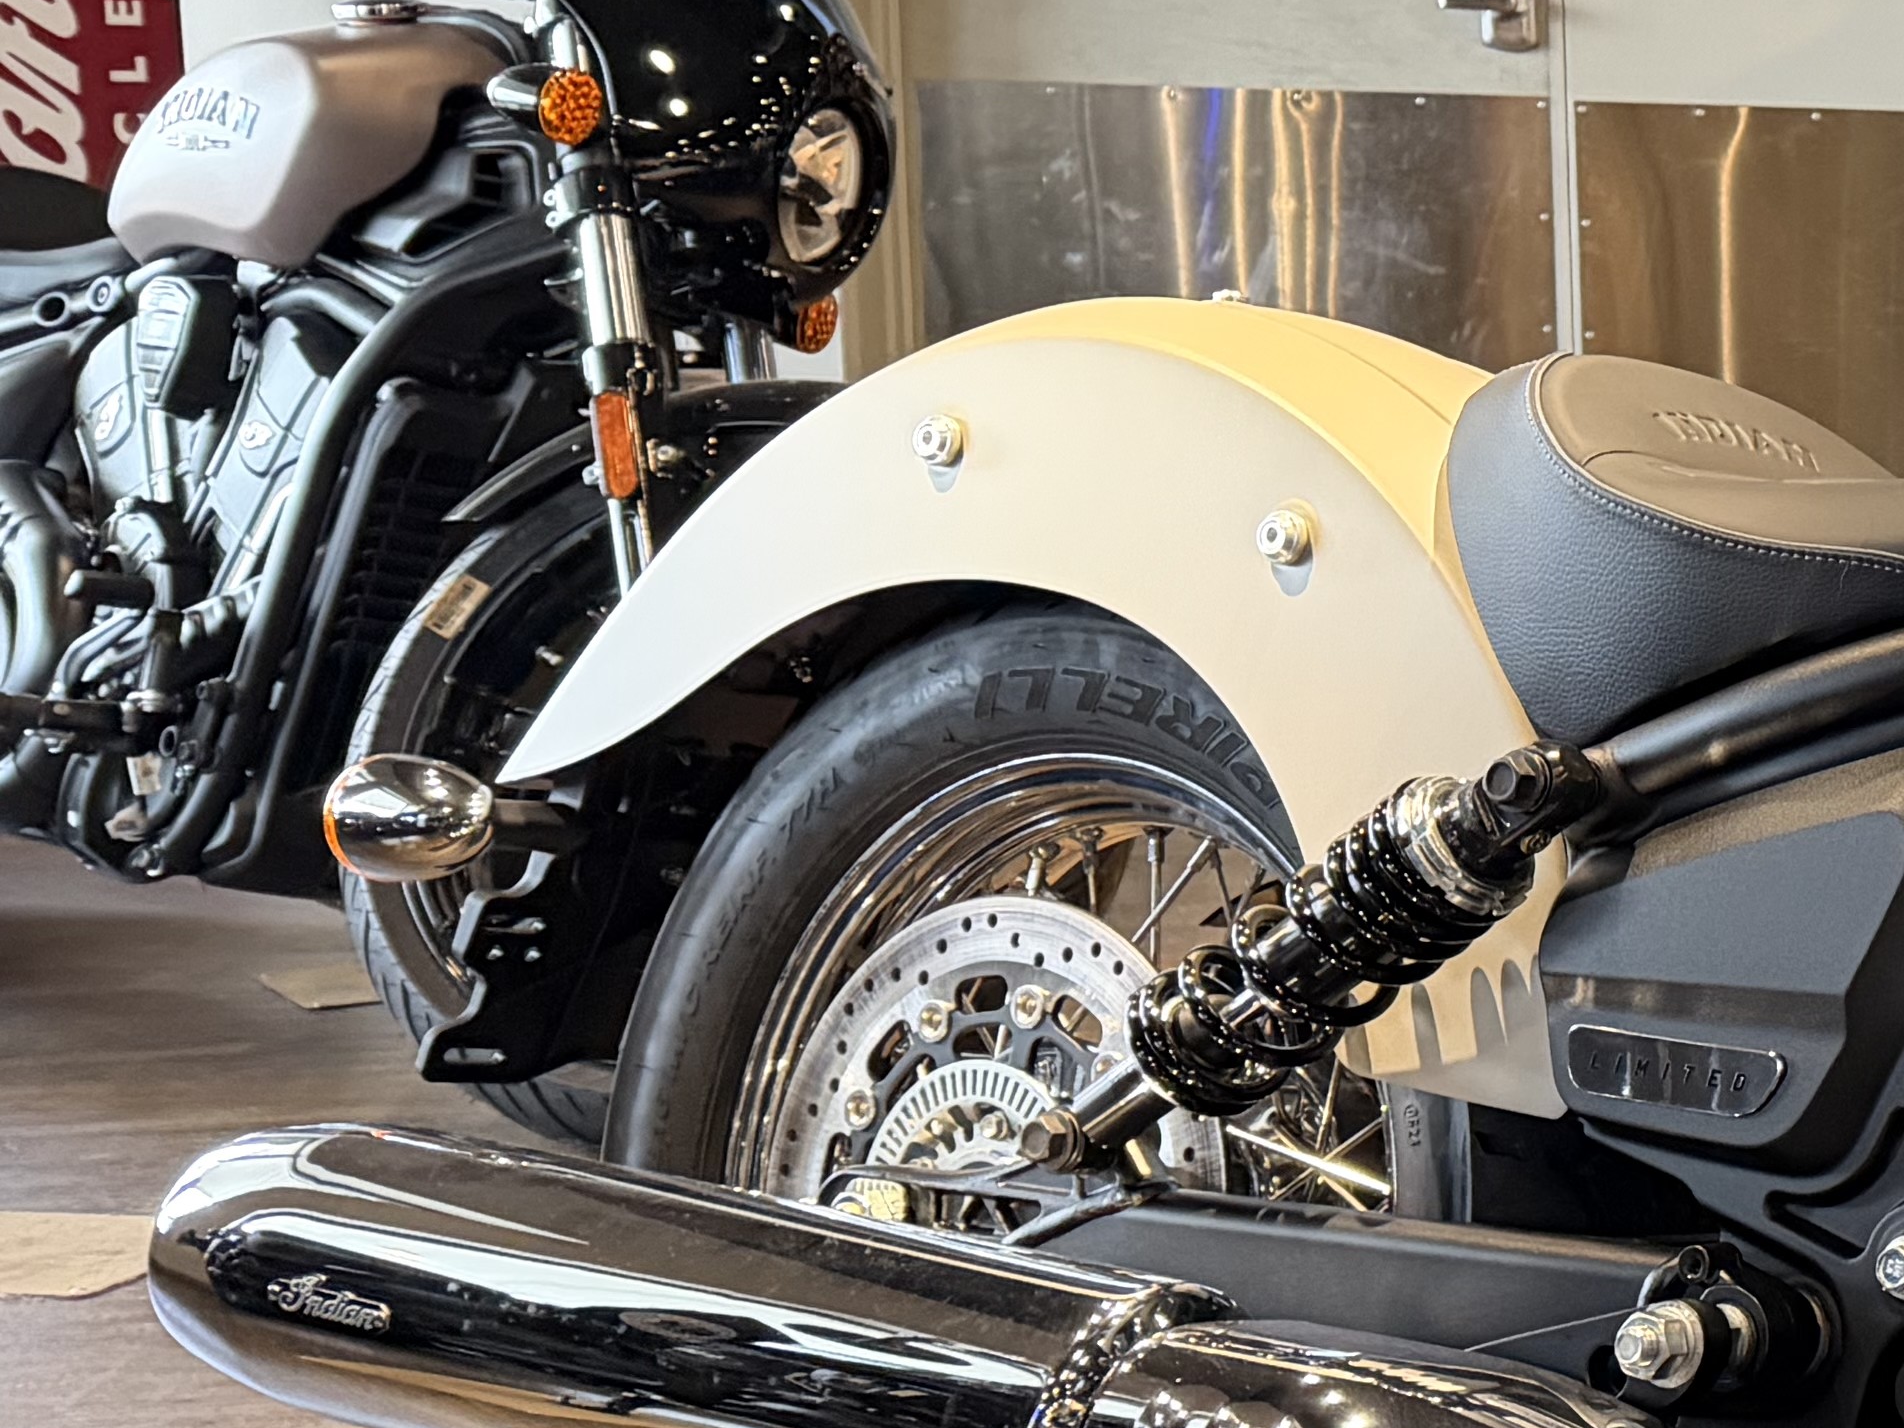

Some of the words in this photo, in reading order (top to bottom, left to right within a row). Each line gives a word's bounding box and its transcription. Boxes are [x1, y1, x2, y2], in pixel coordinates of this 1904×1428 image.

[972, 666, 1281, 811] PIRELLI
[1587, 1049, 1749, 1093] LIMITED
[277, 1272, 378, 1331] Indian
